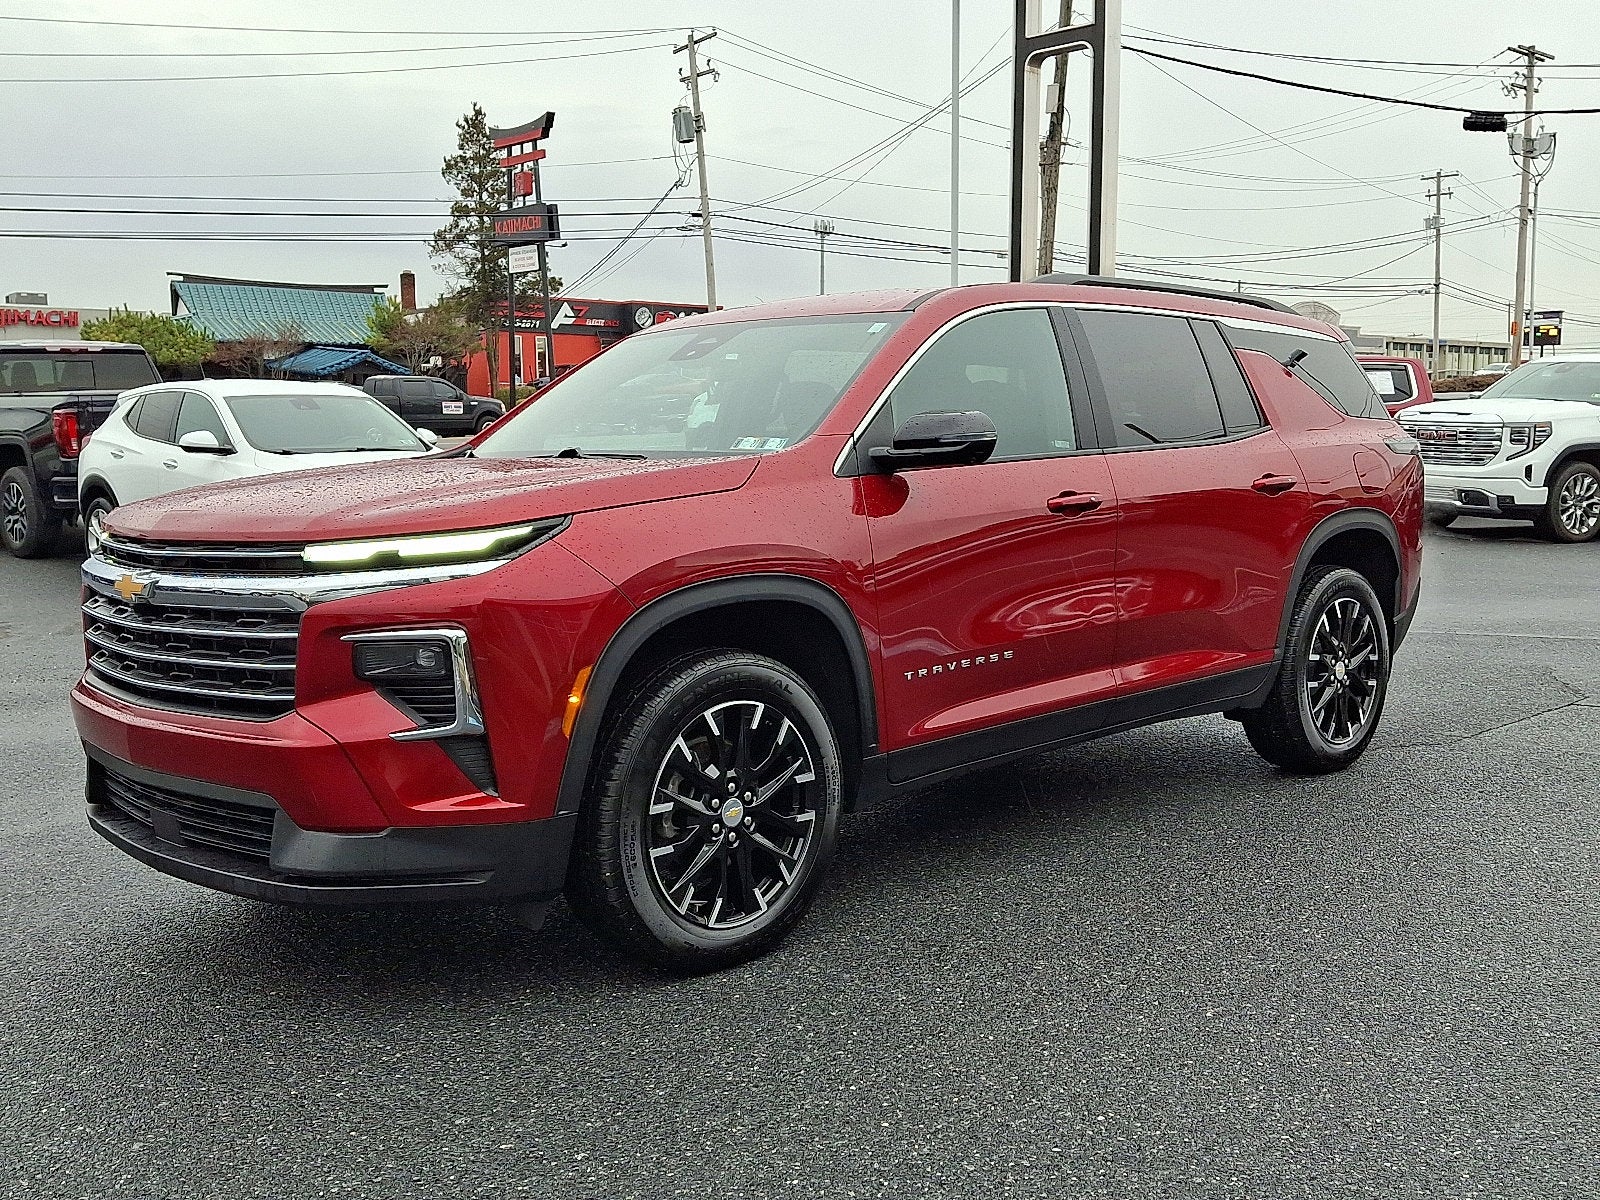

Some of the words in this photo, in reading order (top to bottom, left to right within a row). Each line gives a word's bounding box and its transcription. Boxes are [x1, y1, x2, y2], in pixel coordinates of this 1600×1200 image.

[494, 215, 542, 236] KAJIMACHI
[1418, 430, 1457, 441] GMC
[903, 650, 1014, 681] TRAVERSE
